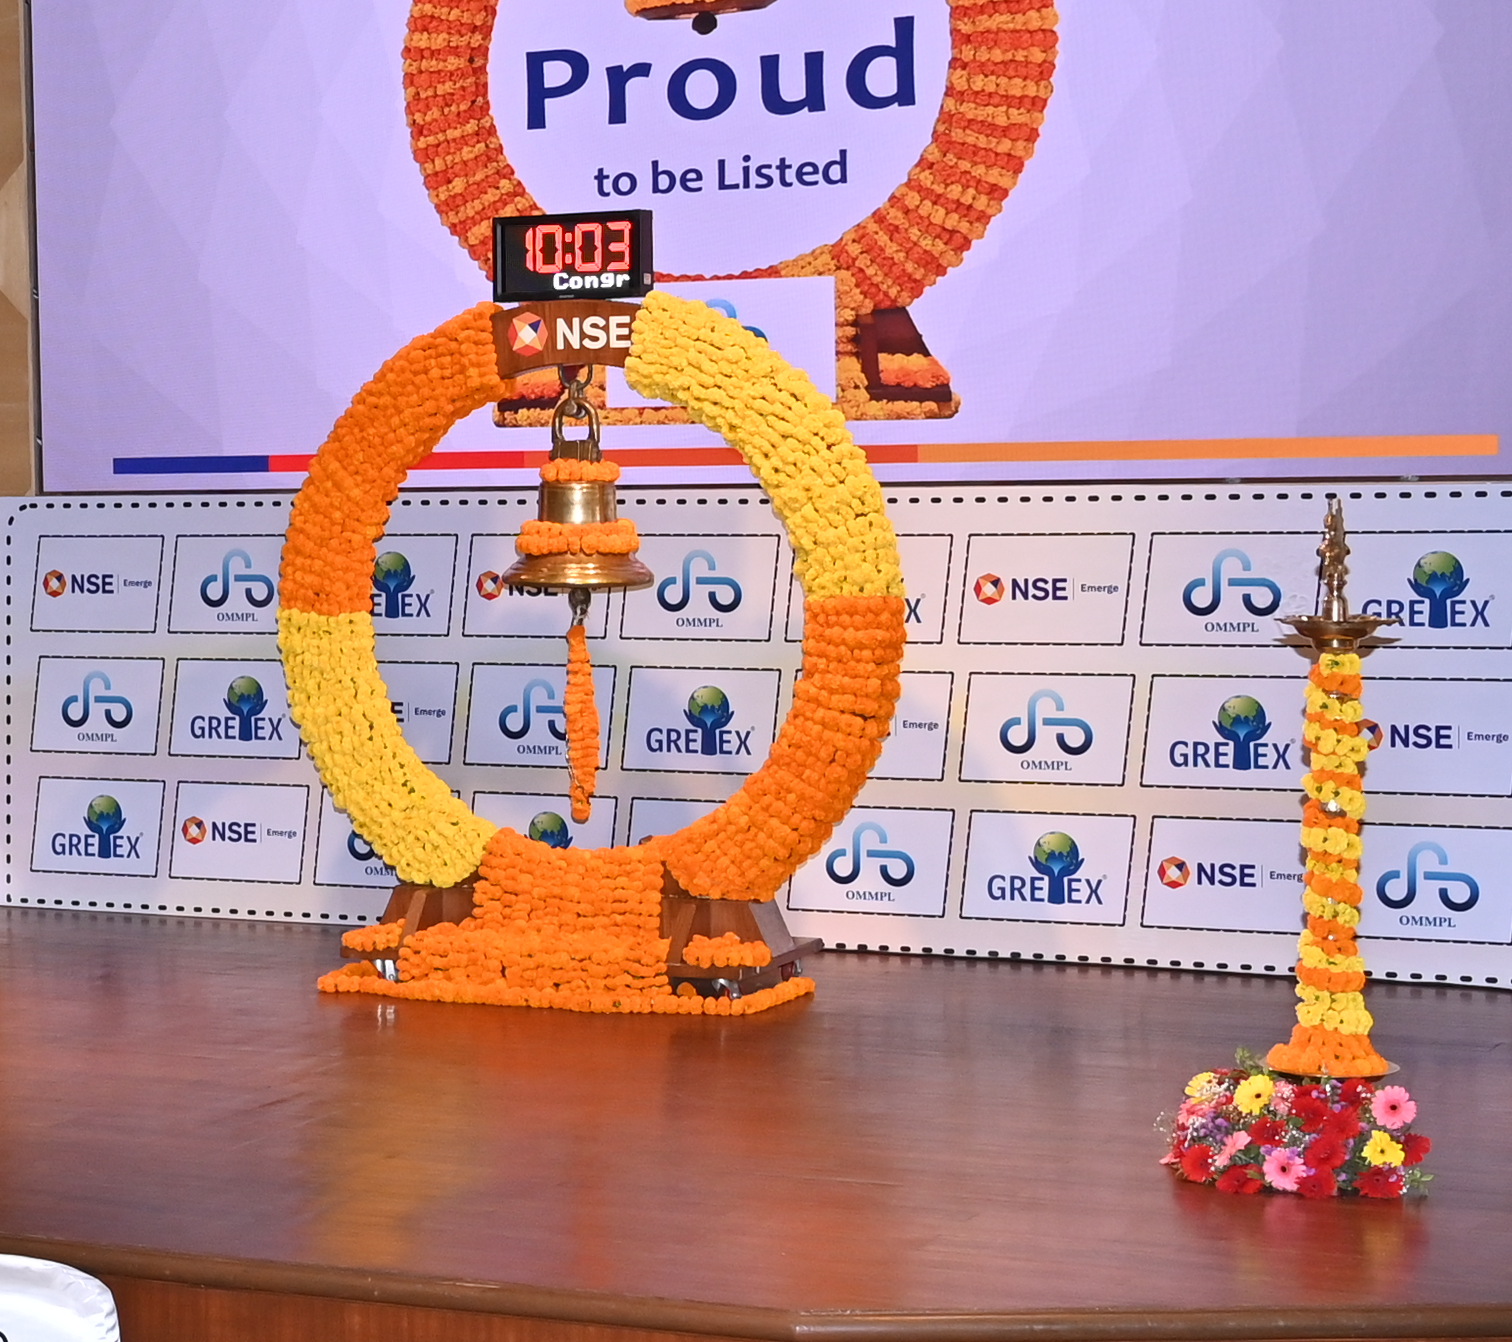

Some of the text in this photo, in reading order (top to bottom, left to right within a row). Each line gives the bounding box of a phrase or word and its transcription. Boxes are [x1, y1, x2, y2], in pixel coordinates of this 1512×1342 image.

[526, 15, 916, 130] Proud
[594, 148, 848, 197] to be Listed
[525, 221, 632, 273] 10:03
[553, 272, 631, 290] Congr
[556, 315, 632, 350] NSE
[70, 574, 114, 594] NSE
[1010, 576, 1119, 601] NSE Emerge
[676, 617, 723, 628] OMMPL
[1204, 621, 1259, 633] OMMPL
[1390, 724, 1454, 749] NSE
[1020, 759, 1073, 771] OMMPL
[1169, 740, 1291, 770] GRETEX
[211, 821, 257, 843] NSE
[1197, 862, 1257, 888] NSE
